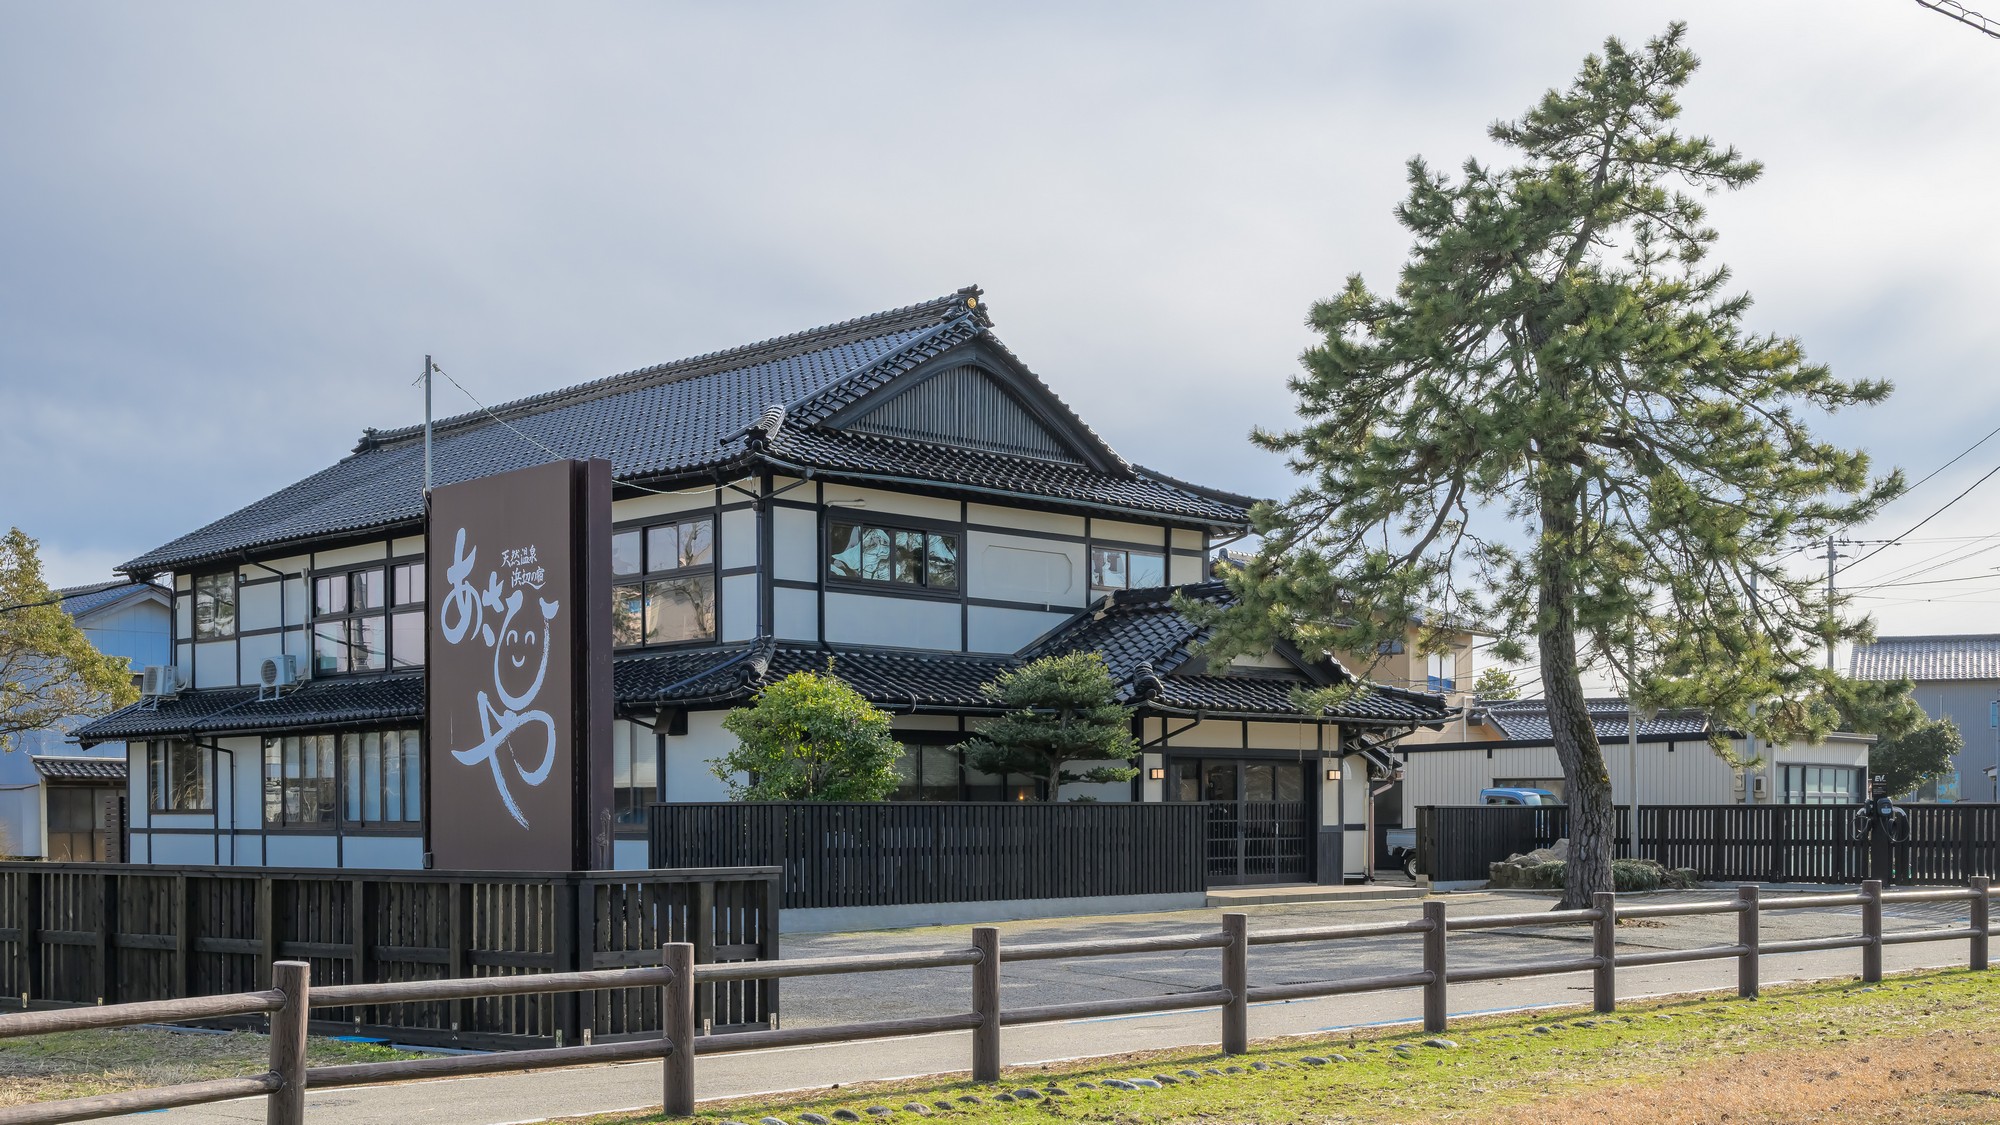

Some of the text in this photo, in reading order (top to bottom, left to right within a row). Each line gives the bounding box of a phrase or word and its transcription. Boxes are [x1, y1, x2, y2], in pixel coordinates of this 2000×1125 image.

[501, 544, 538, 567] 天然温泉
[511, 566, 547, 589] 浜辺の宿
